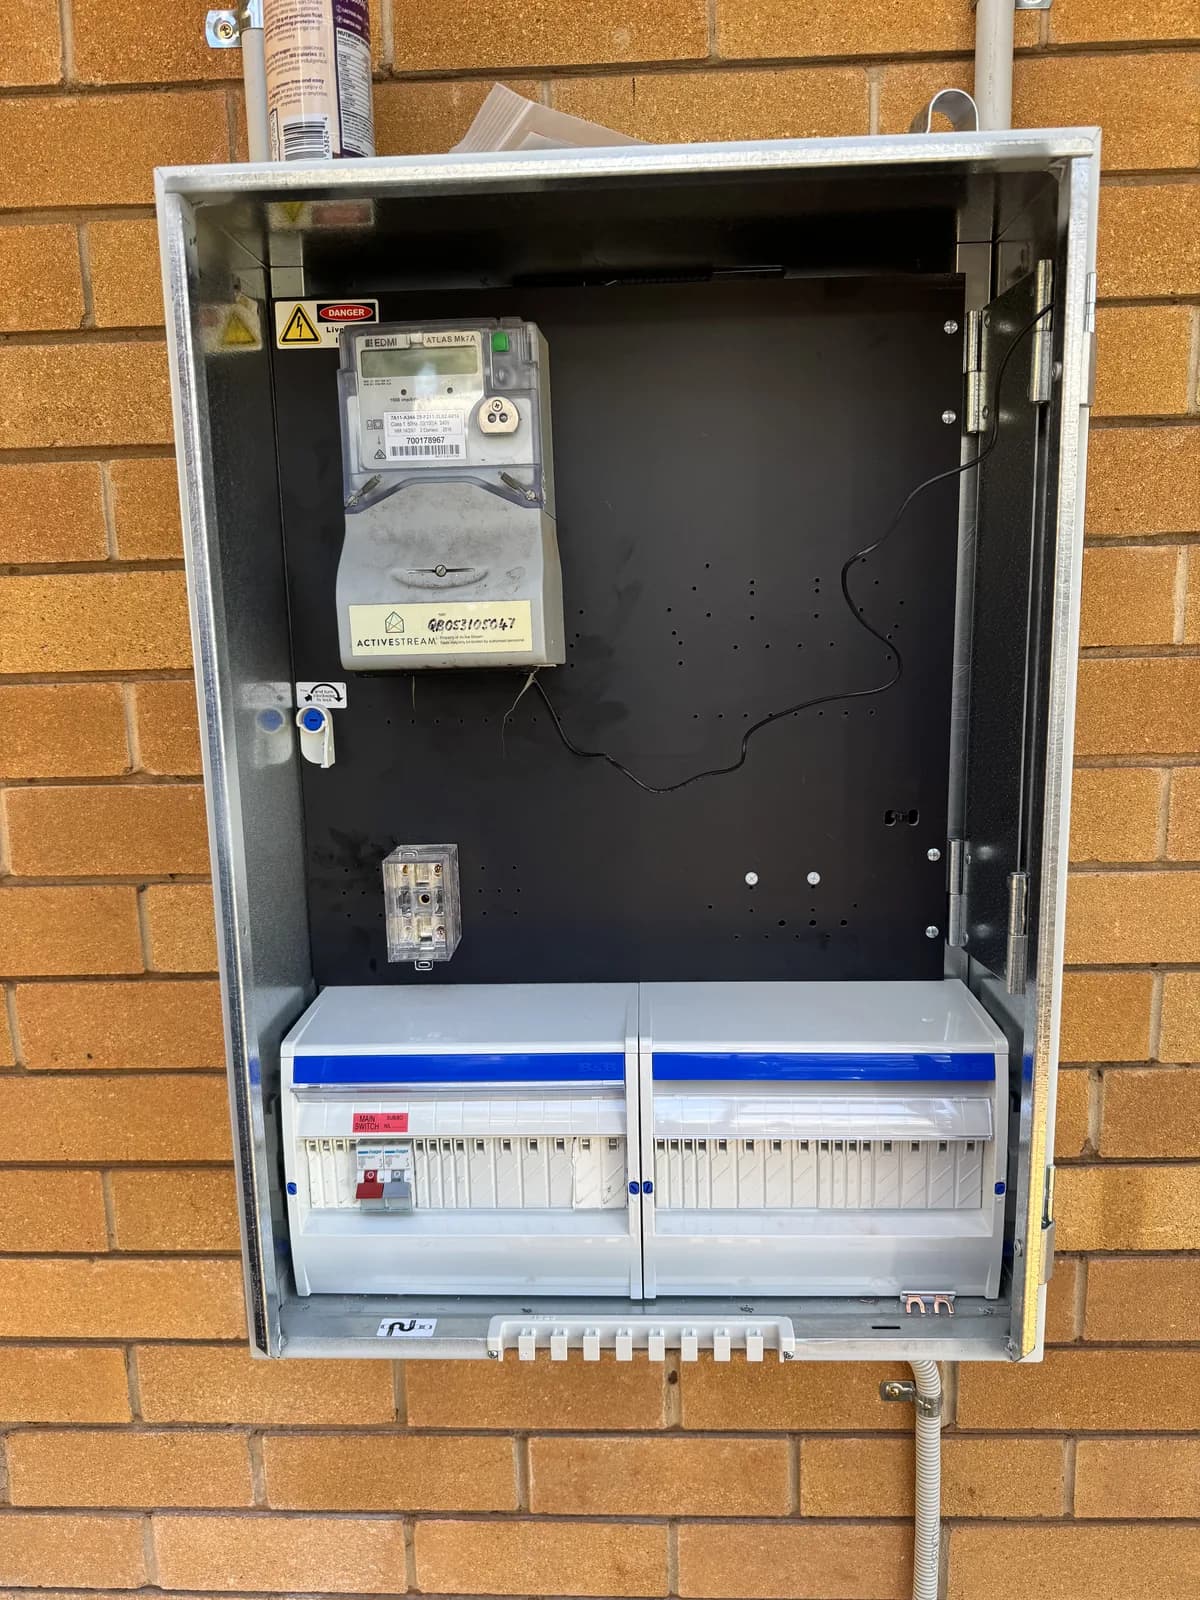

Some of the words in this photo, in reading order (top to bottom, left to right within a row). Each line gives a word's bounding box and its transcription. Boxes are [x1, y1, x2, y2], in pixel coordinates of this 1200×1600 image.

[328, 308, 365, 317] DANGER
[374, 338, 397, 347] EDMI
[426, 335, 453, 344] ATLAS
[454, 334, 476, 343] Mk7A
[406, 435, 445, 445] 700178967
[356, 638, 436, 648] ACTIVESTREAM
[359, 1114, 376, 1123] MAIN
[354, 1122, 380, 1131] SWITCH
